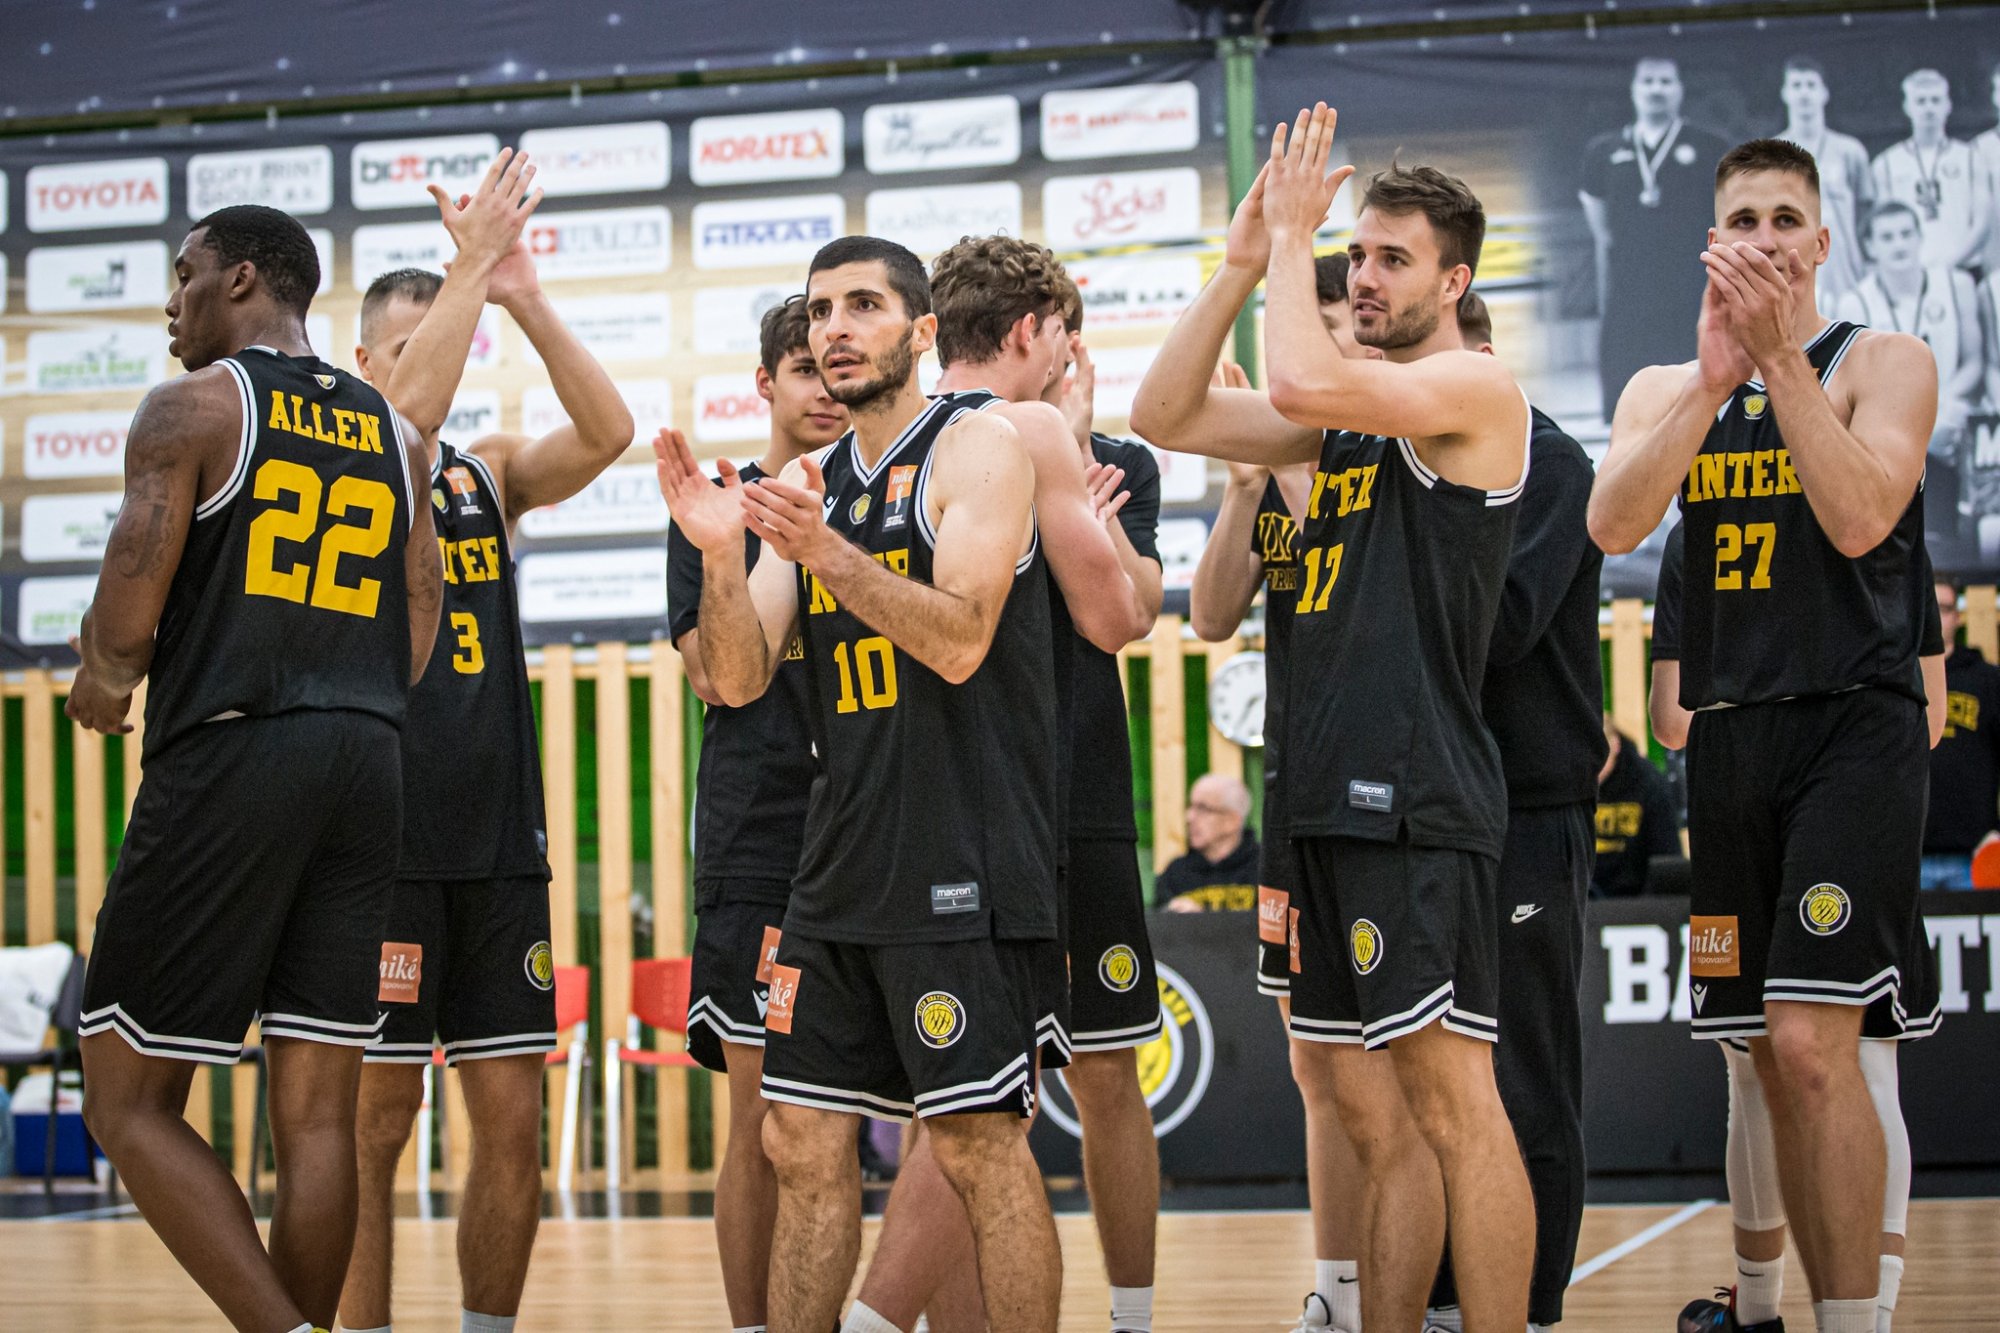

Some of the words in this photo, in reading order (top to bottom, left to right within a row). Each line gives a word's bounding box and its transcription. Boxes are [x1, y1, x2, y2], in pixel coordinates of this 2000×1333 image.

[36, 179, 160, 211] TOYOTA
[269, 390, 384, 454] ALLEN
[33, 426, 127, 460] TOYO
[245, 458, 396, 618] 22
[1715, 522, 1776, 591] 27
[1295, 542, 1344, 615] 17
[450, 612, 485, 675] 3
[834, 636, 898, 714] 10
[1354, 783, 1386, 796] macron
[1366, 796, 1371, 804] L
[937, 887, 971, 898] macron
[1515, 903, 1536, 916] NIKE
[1692, 926, 1733, 954] niké
